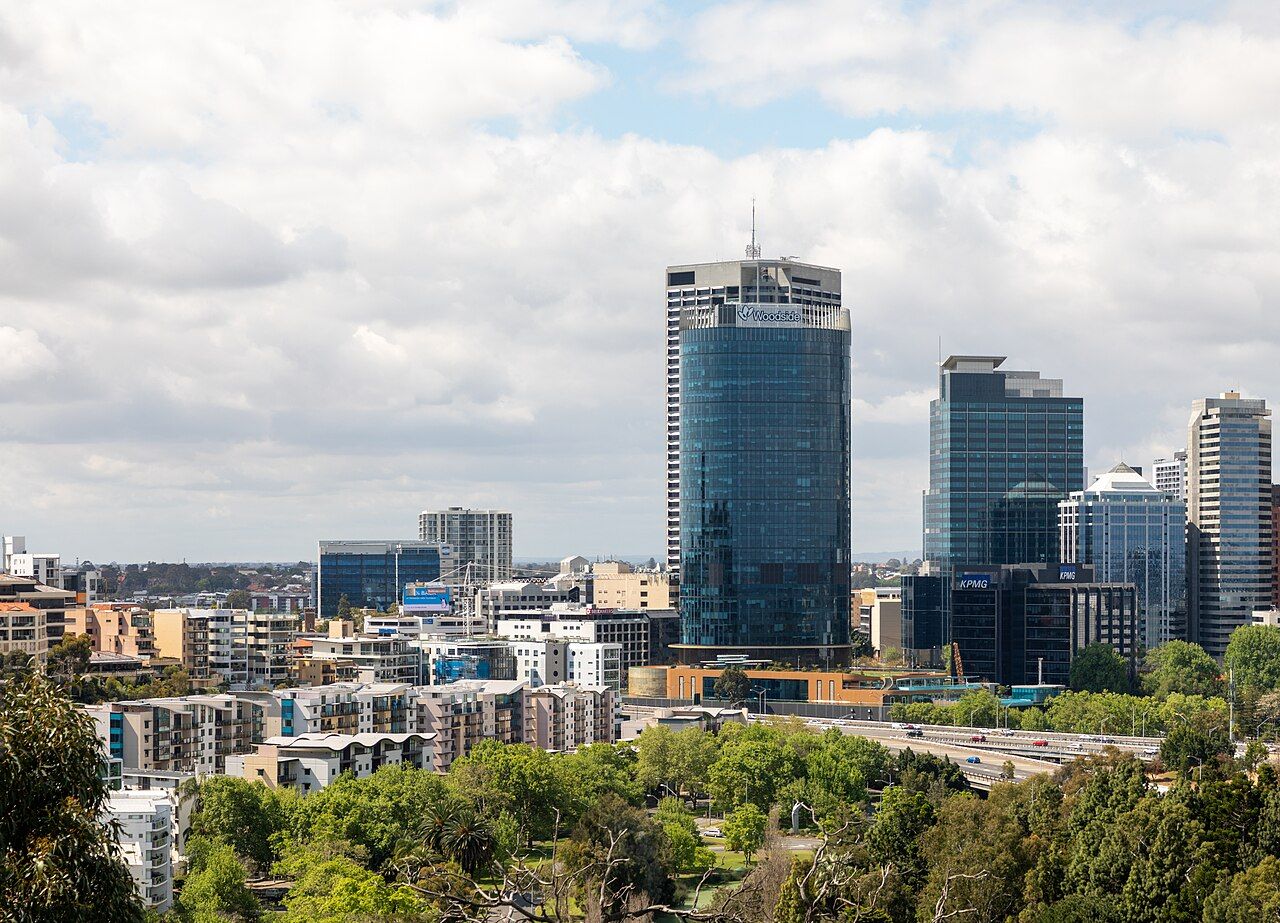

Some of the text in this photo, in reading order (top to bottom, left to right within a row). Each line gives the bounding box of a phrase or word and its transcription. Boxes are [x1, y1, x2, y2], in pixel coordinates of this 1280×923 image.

[753, 311, 801, 322] Woodside
[1060, 571, 1076, 580] KPMG
[960, 579, 988, 588] KPMG
